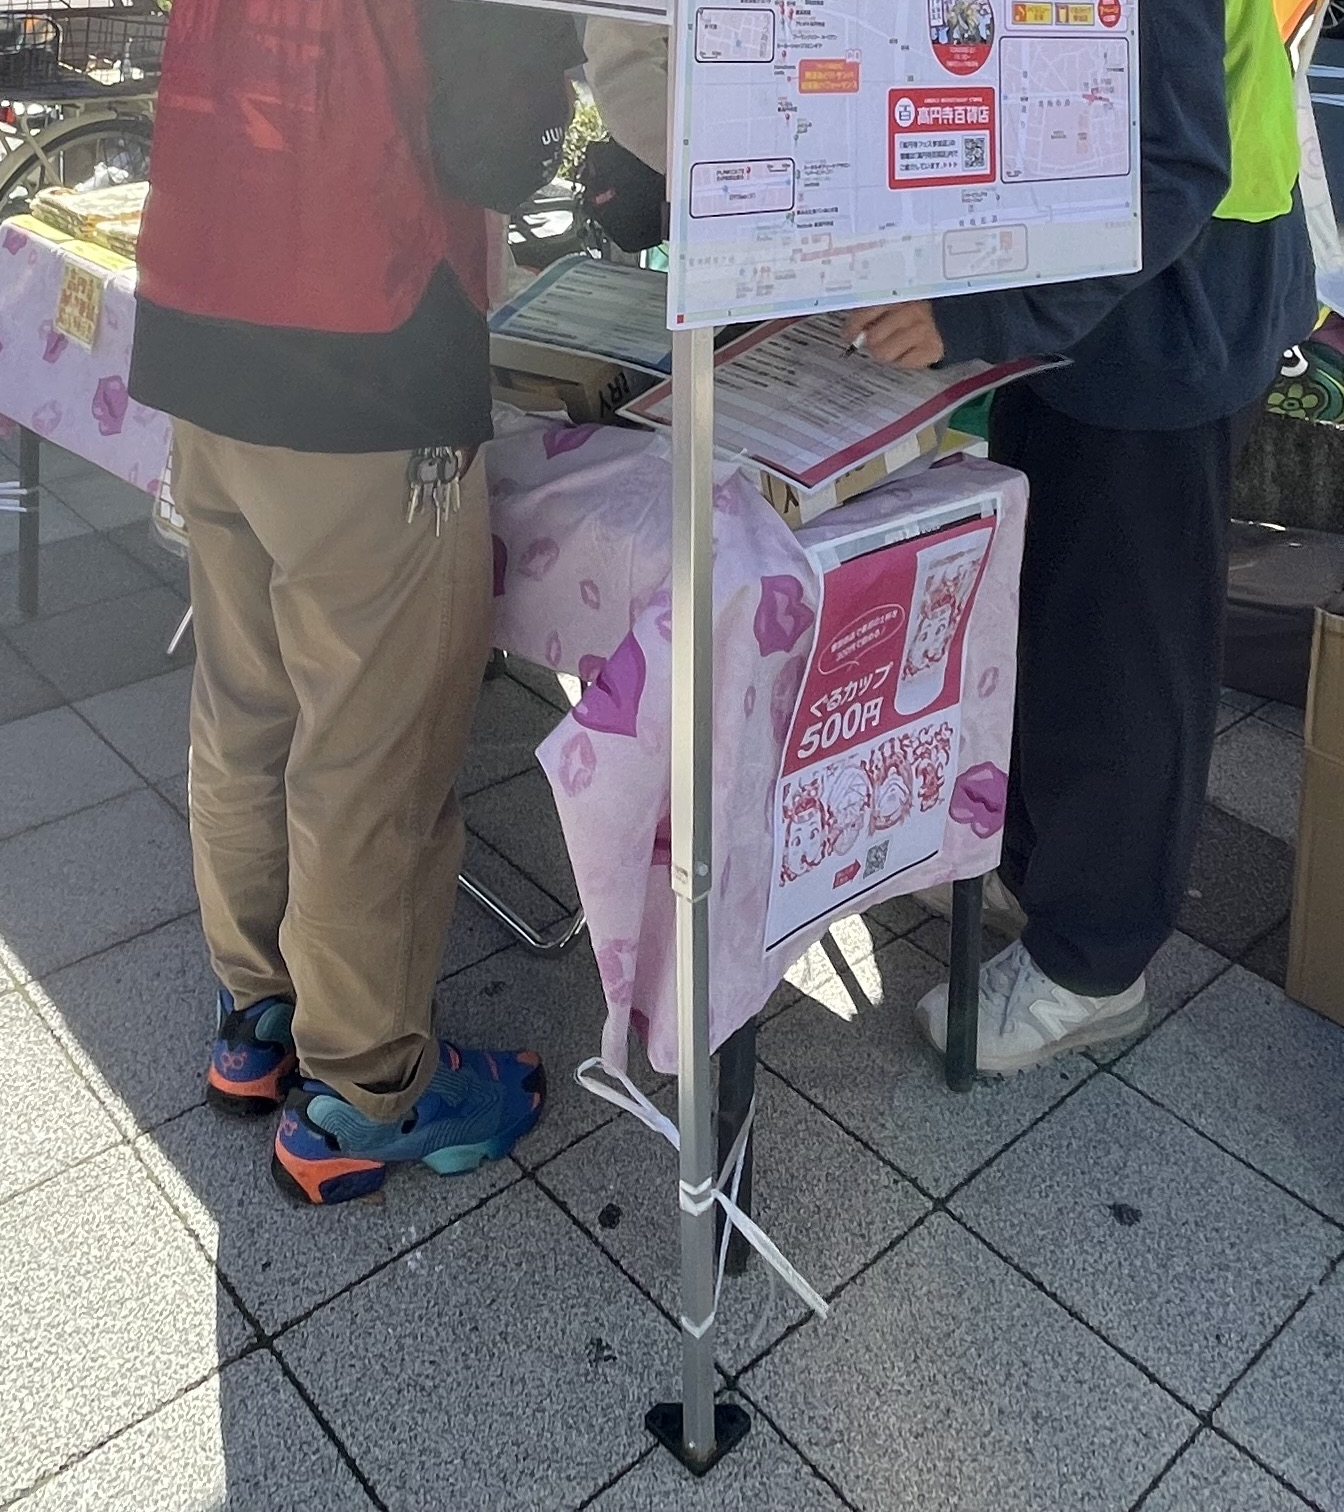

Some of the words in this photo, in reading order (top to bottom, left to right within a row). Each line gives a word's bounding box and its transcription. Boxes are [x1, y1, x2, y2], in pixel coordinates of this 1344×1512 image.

[809, 659, 895, 719] ぐるカップ
[796, 696, 885, 760] 500円
